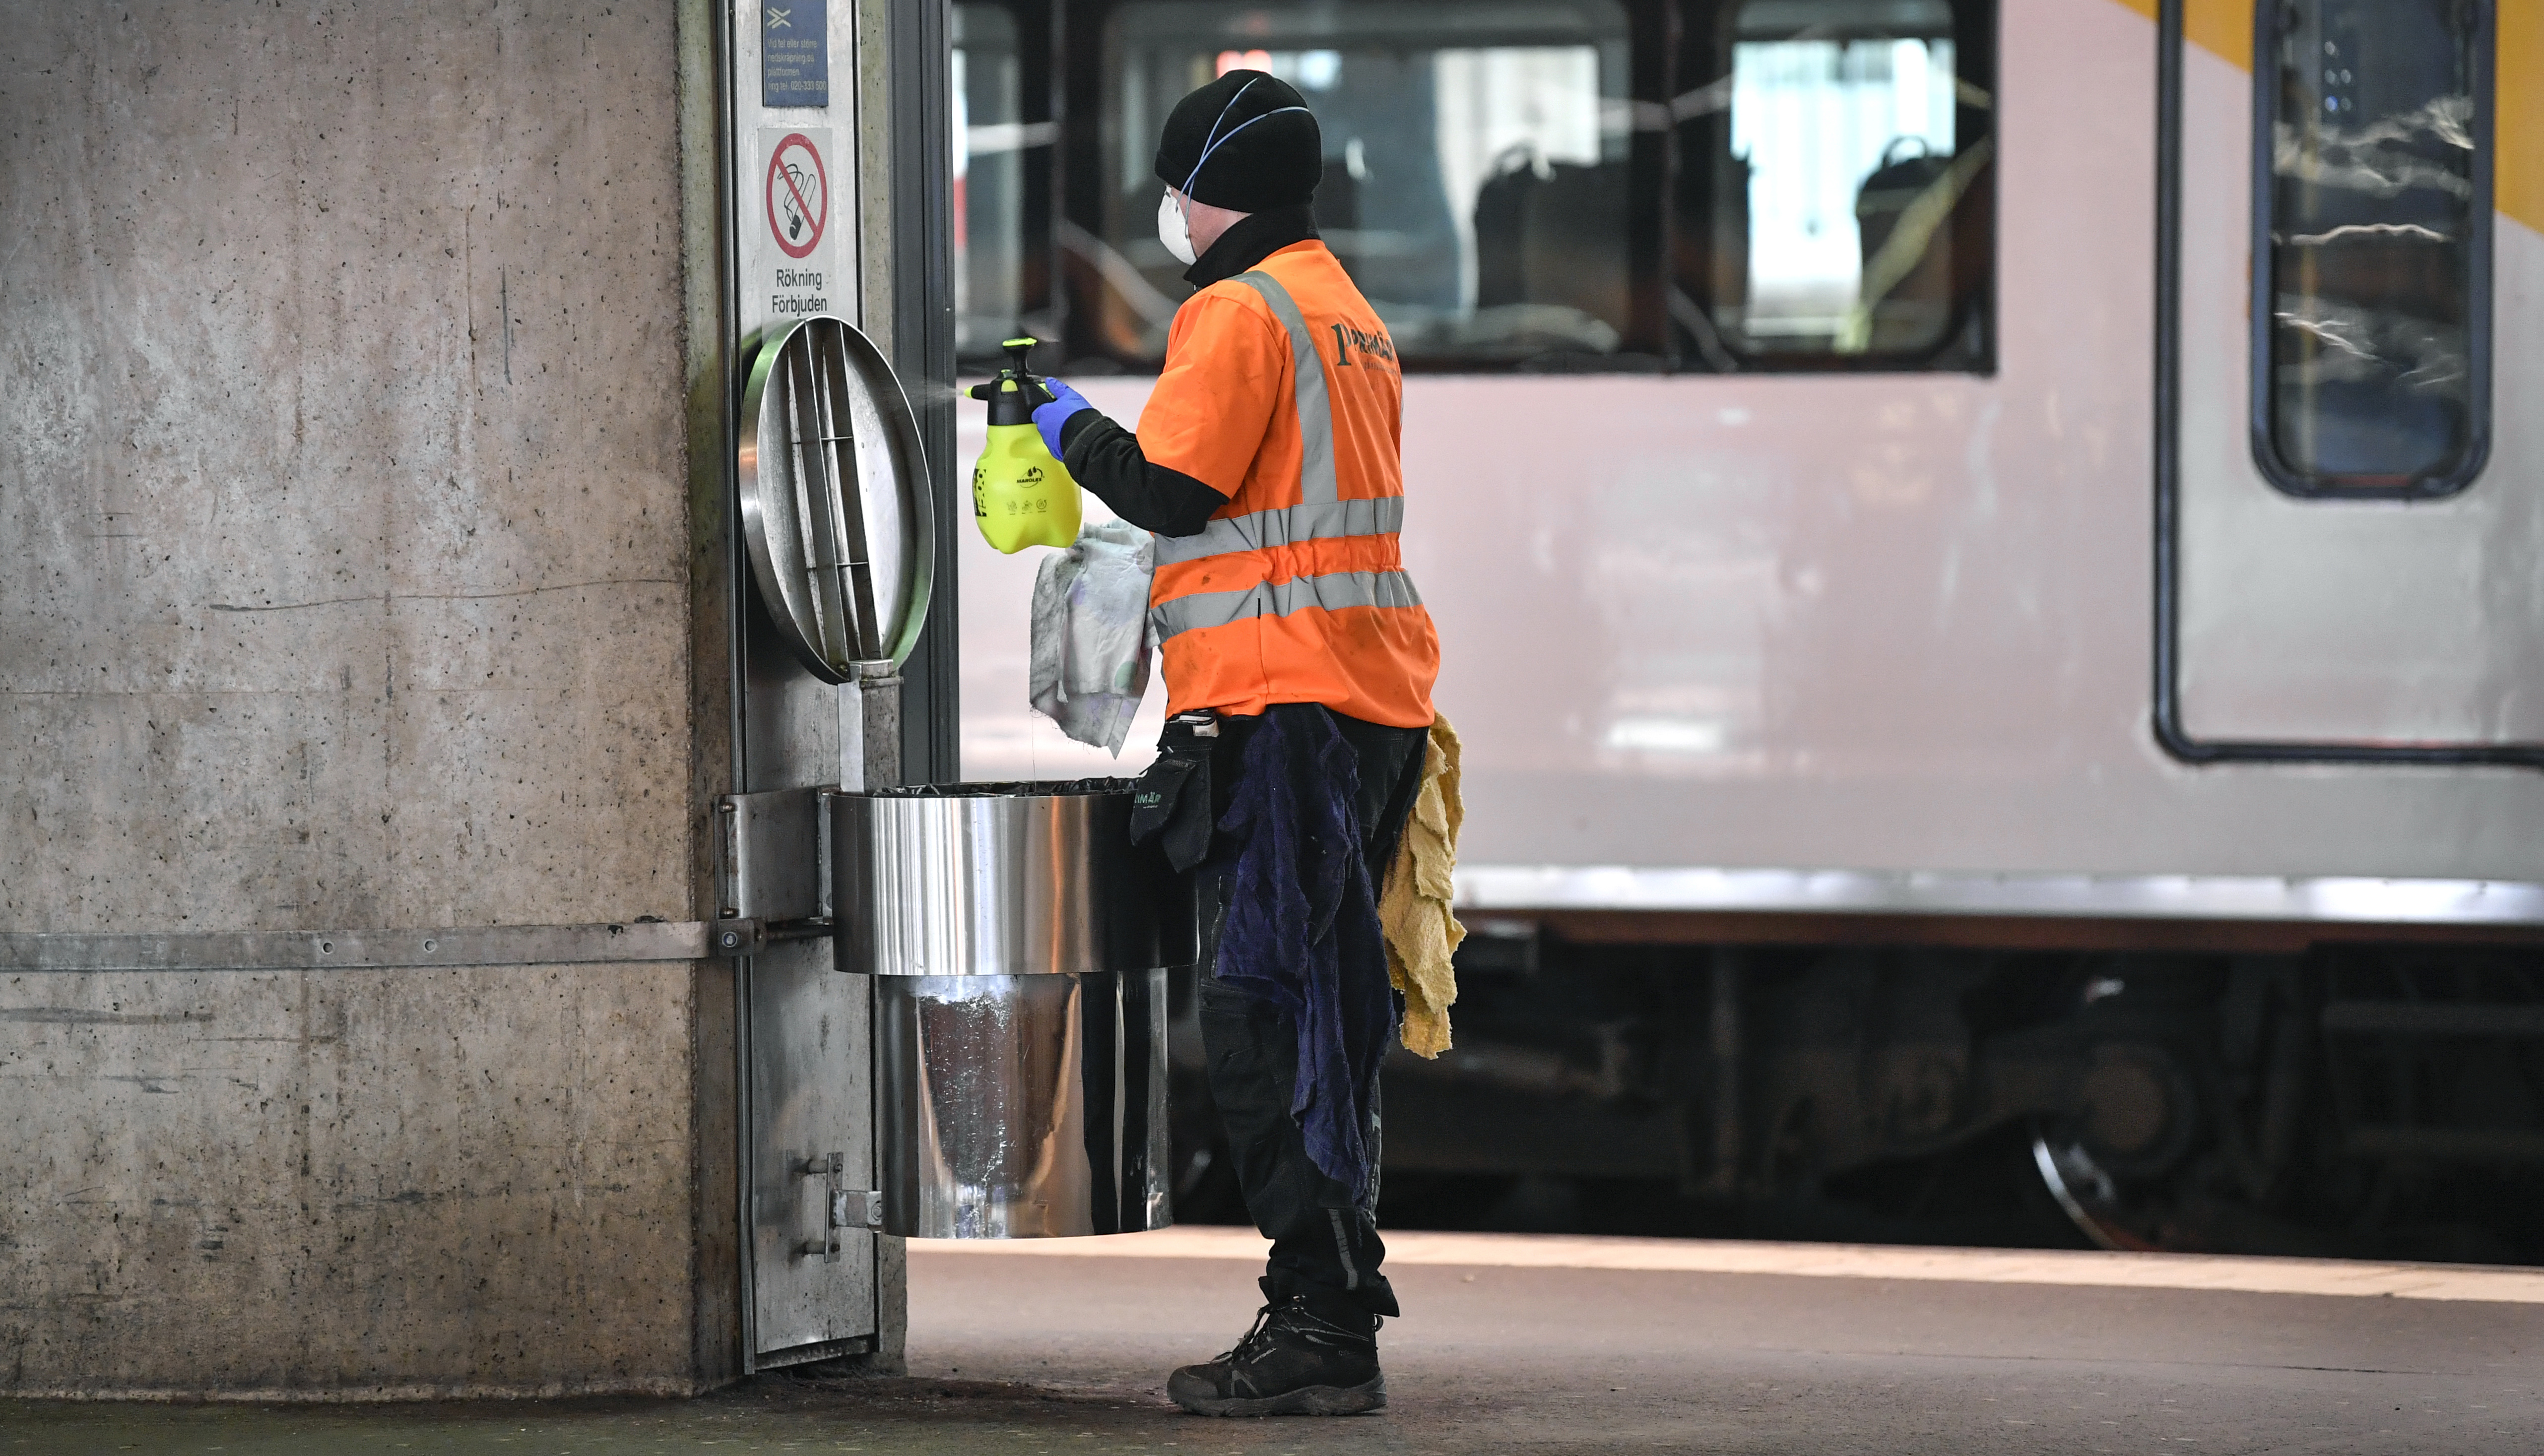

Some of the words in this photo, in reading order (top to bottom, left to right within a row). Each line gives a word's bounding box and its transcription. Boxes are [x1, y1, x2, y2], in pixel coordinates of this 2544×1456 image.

[768, 39, 777, 48] Vid
[786, 39, 799, 48] eller
[801, 39, 817, 48] större
[768, 81, 779, 92] ring
[790, 80, 814, 90] 020-333
[815, 80, 826, 90] 500
[776, 268, 822, 291] Rökning
[772, 294, 827, 317] Förbjuden
